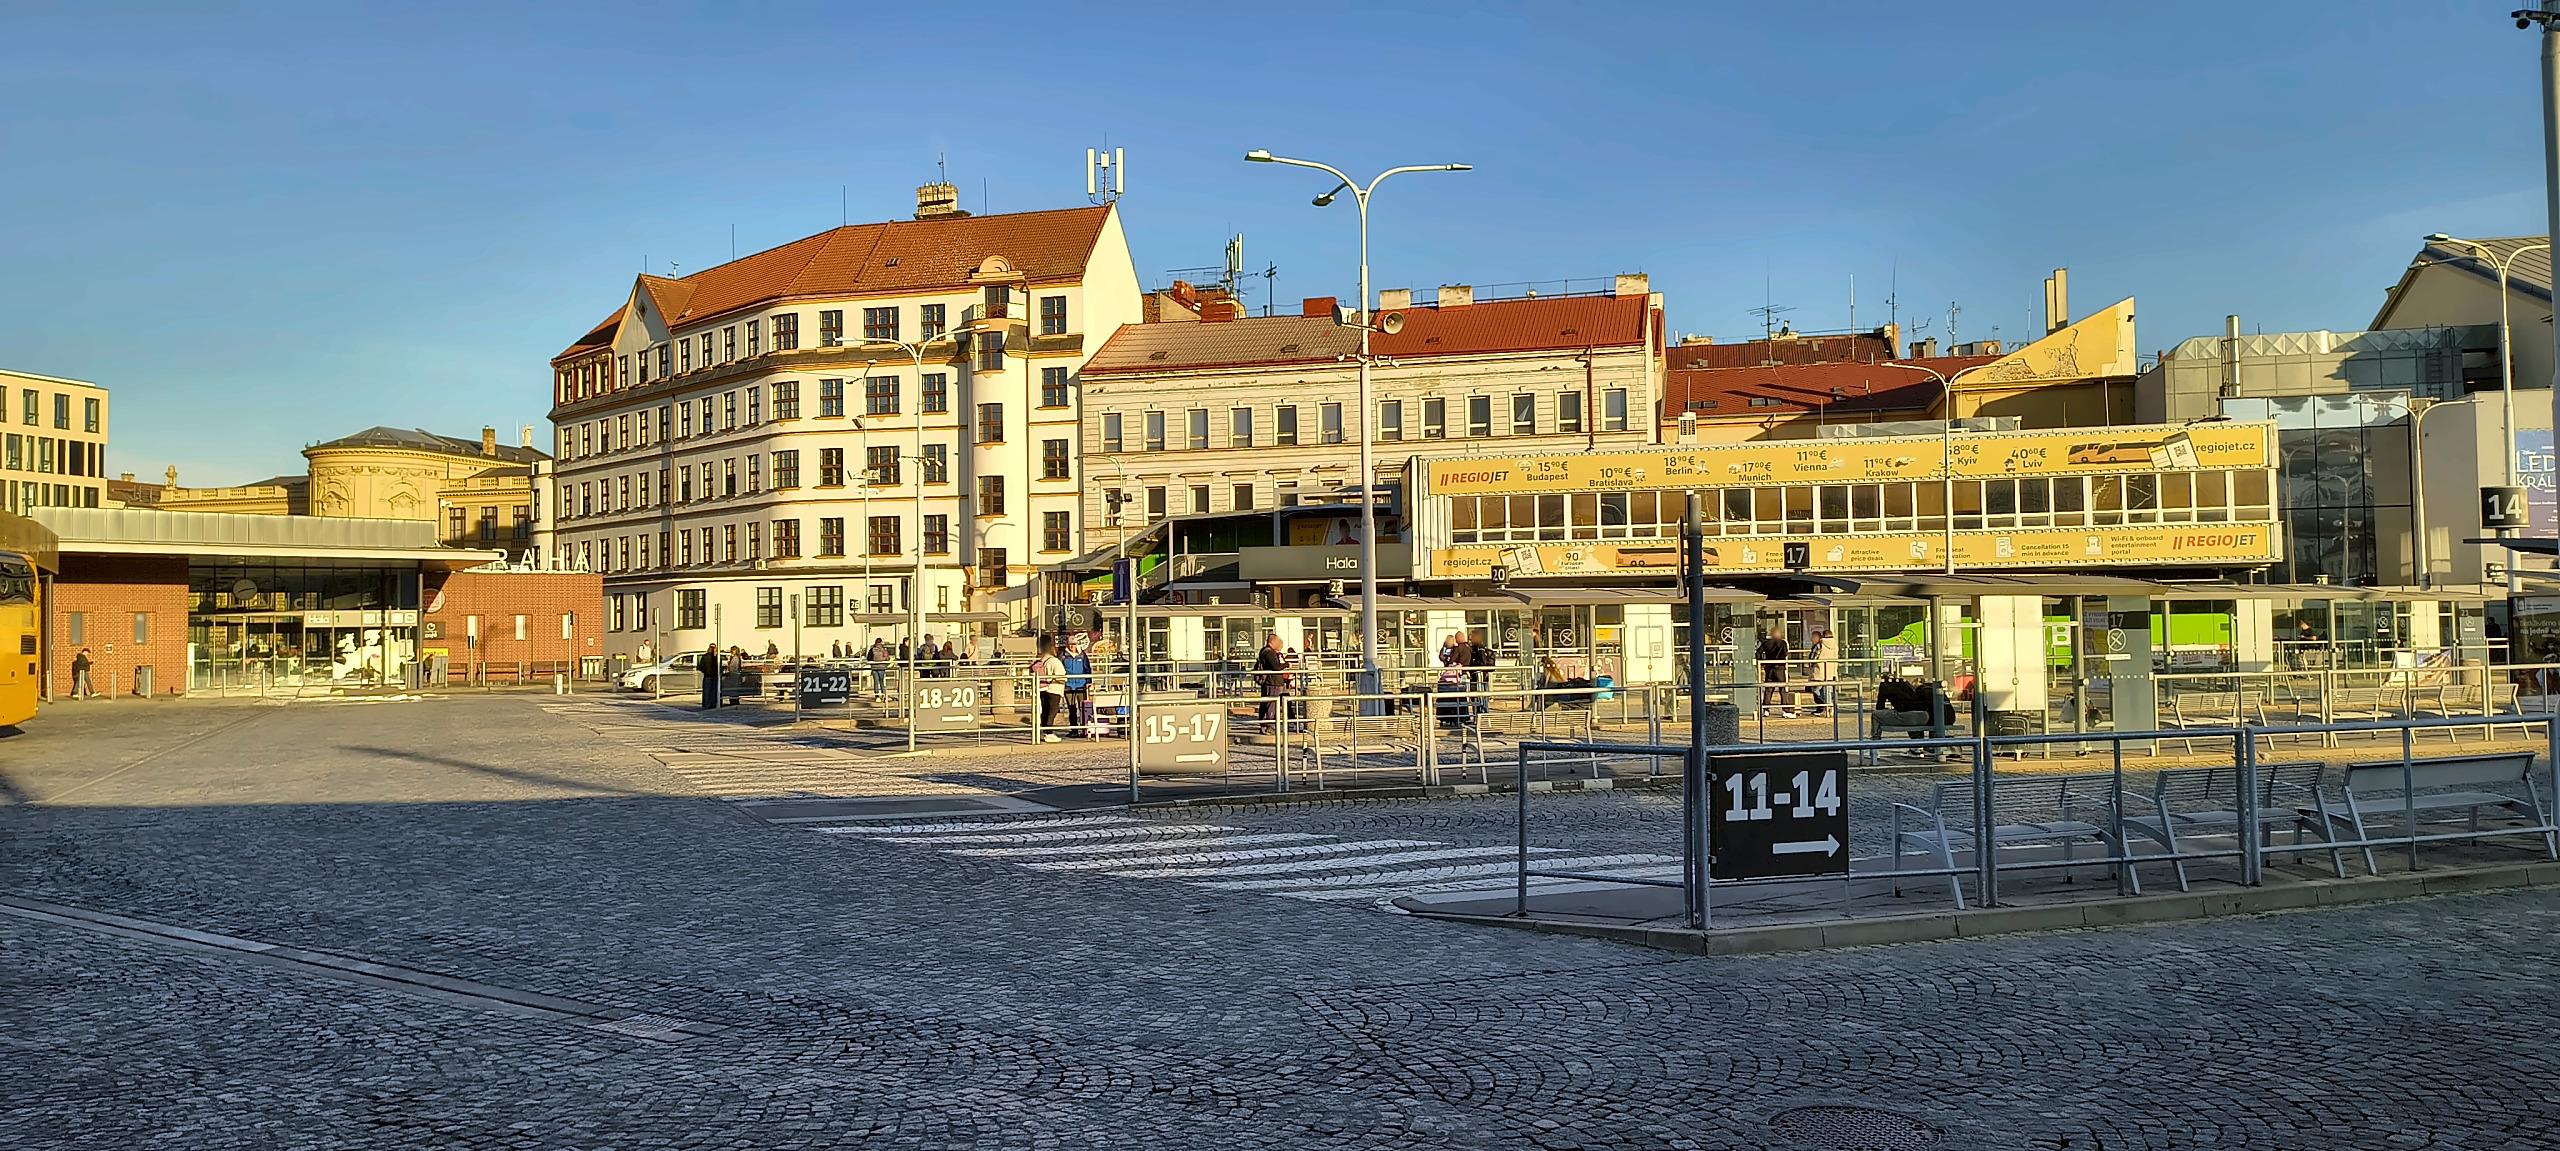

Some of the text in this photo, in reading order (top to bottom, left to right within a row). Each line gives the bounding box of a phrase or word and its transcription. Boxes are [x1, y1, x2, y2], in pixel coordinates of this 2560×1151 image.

[2195, 441, 2256, 454] regiojet.cz
[1793, 463, 1828, 472] Vienna
[1957, 456, 1978, 467] Kyiv
[2022, 459, 2043, 468] Lviv
[1451, 471, 1509, 484] REGIOJET
[1526, 472, 1569, 482] Budapest
[1665, 467, 1693, 475] Berlin
[1738, 473, 1772, 482] Munich
[1865, 469, 1899, 477] Krakow
[1589, 478, 1634, 487] Bratislava
[2488, 493, 2523, 520] 14
[2186, 534, 2257, 548] REGIOJET
[478, 541, 591, 571] RAHA
[1565, 552, 1579, 561] 90
[1786, 547, 1806, 564] 17
[1325, 556, 1358, 569] Hala
[1443, 557, 1493, 568] regiojet.cz
[1492, 568, 1505, 581] 20
[1330, 581, 1343, 592] 22
[1731, 616, 1742, 627] 20
[2110, 613, 2124, 628] 17
[803, 676, 848, 693] 21-22
[918, 687, 976, 709] 18-20
[1144, 712, 1222, 745] 15-17
[1724, 769, 1842, 822] 11-14
